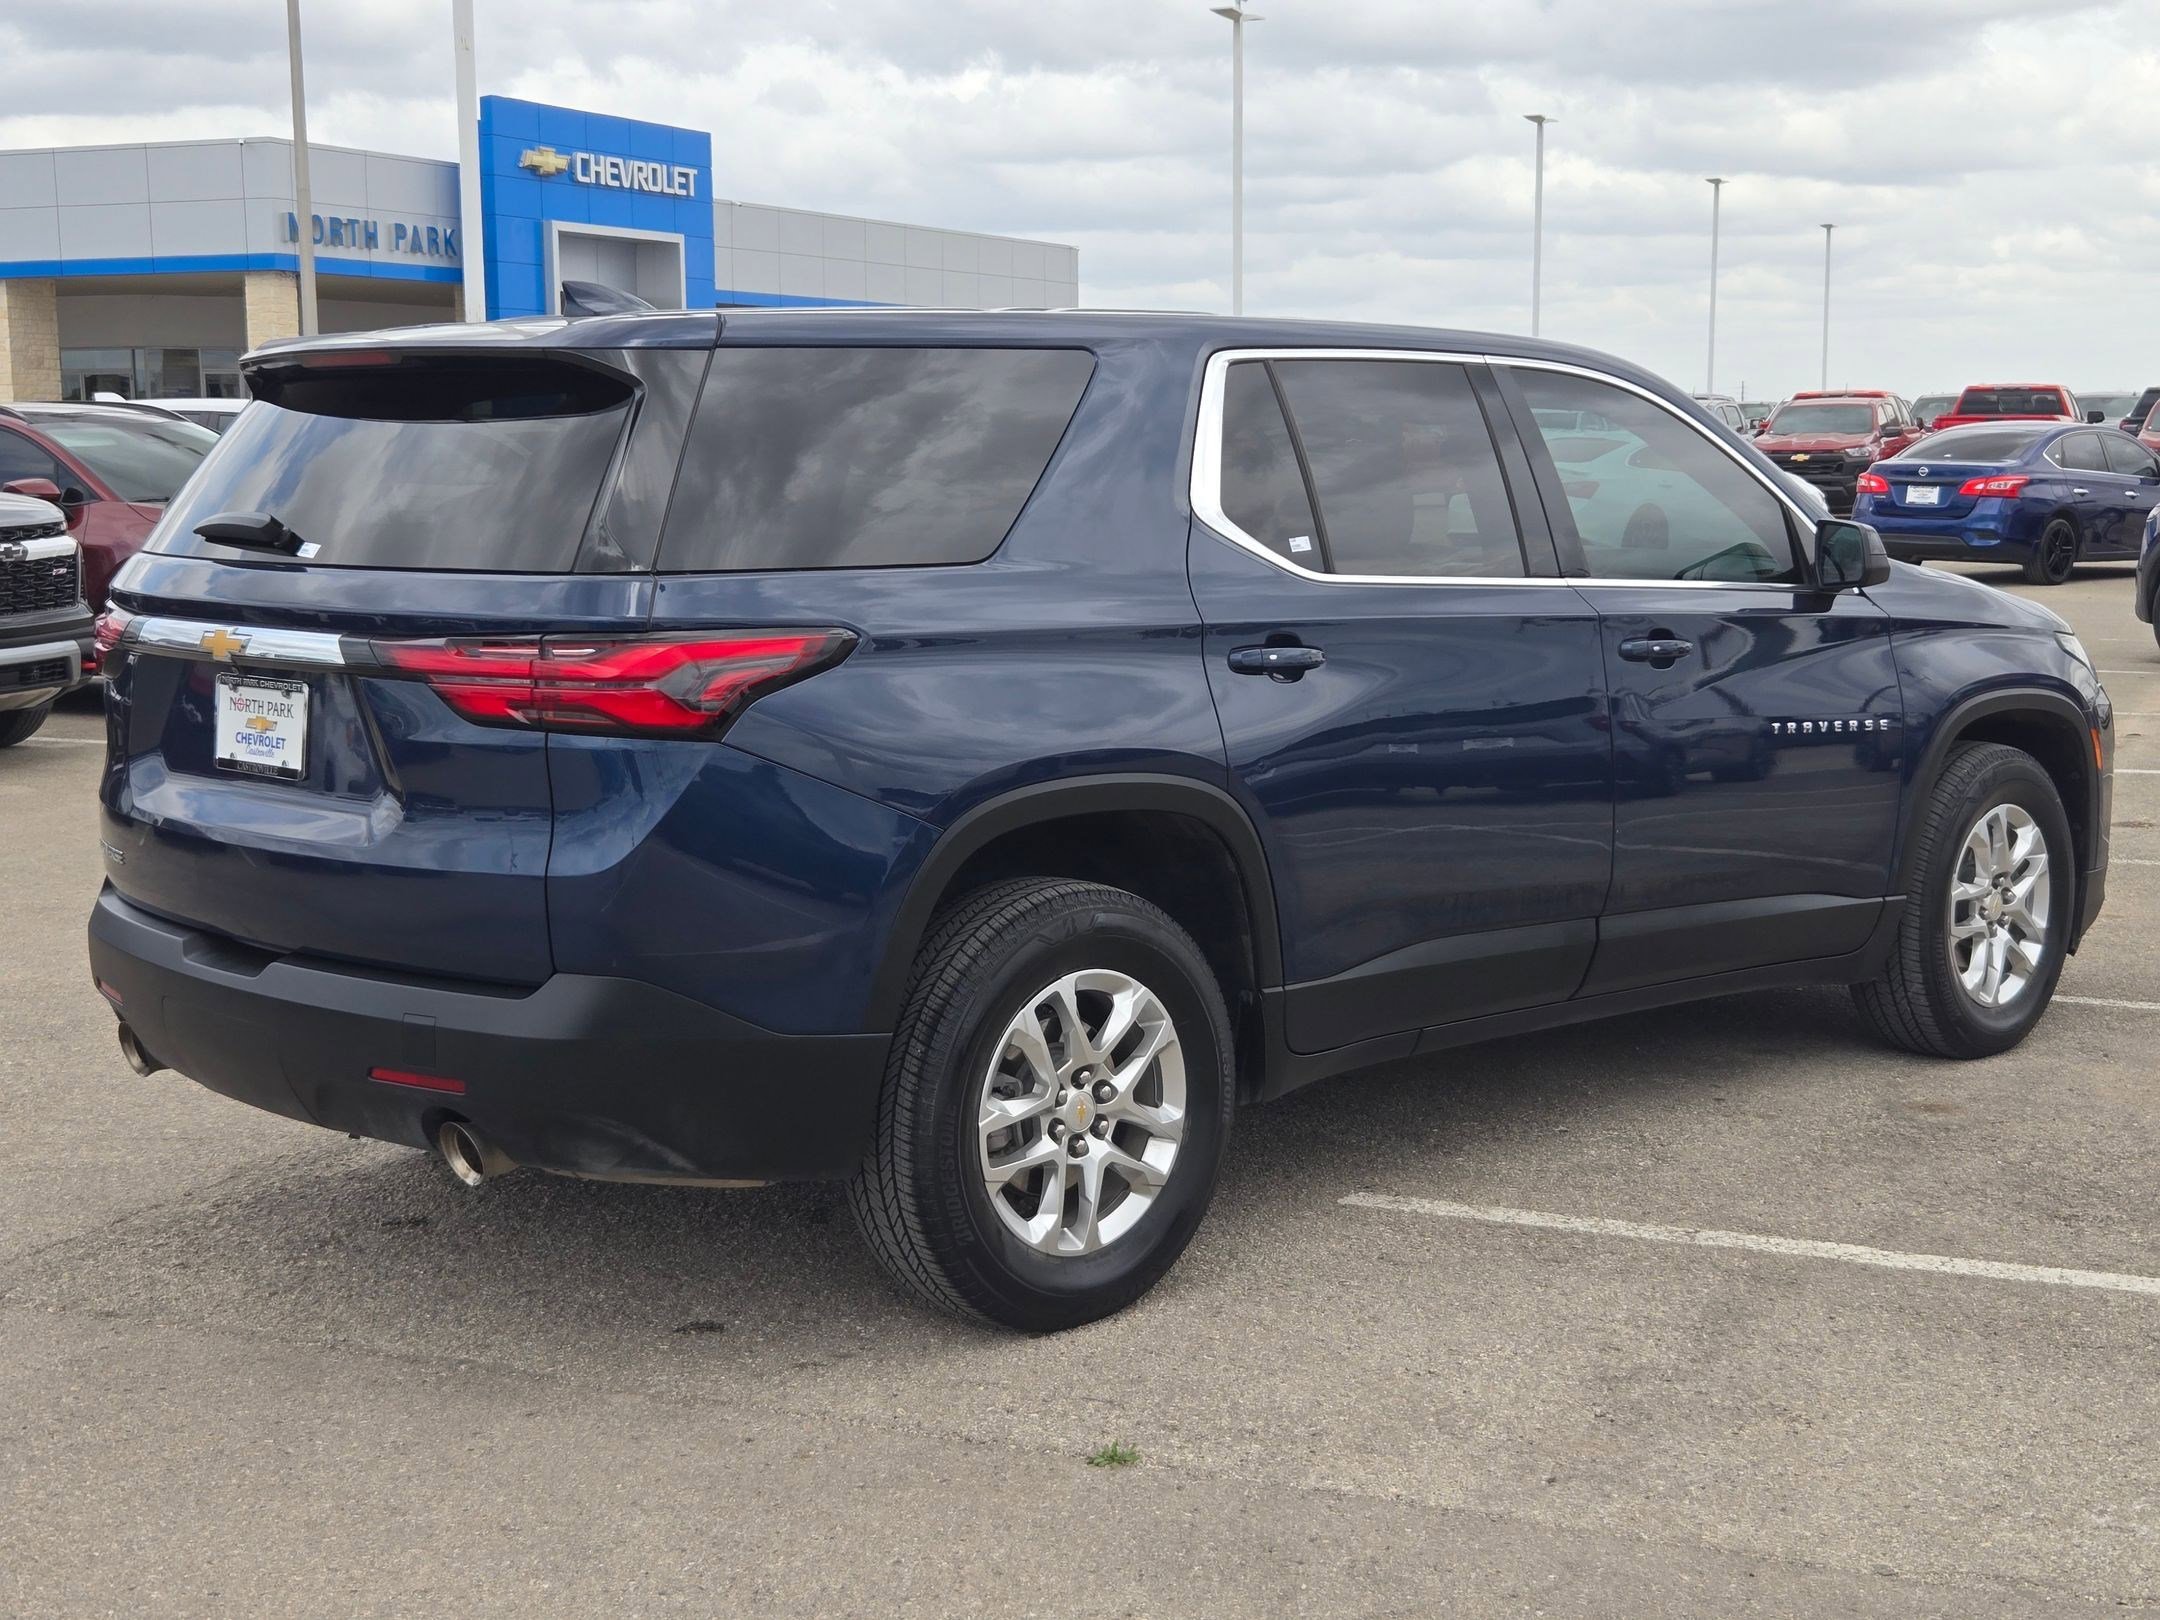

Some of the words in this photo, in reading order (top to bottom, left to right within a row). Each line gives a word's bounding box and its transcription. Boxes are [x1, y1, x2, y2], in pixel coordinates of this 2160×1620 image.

[573, 151, 698, 197] CHEVROLET
[284, 211, 379, 249] NORTH
[394, 222, 458, 257] PARK
[259, 681, 302, 692] CHEVROLET
[229, 696, 264, 714] NORTH
[267, 701, 294, 718] PARK
[1771, 719, 1888, 734] TRAVERSE
[235, 731, 286, 749] CHEVROLET
